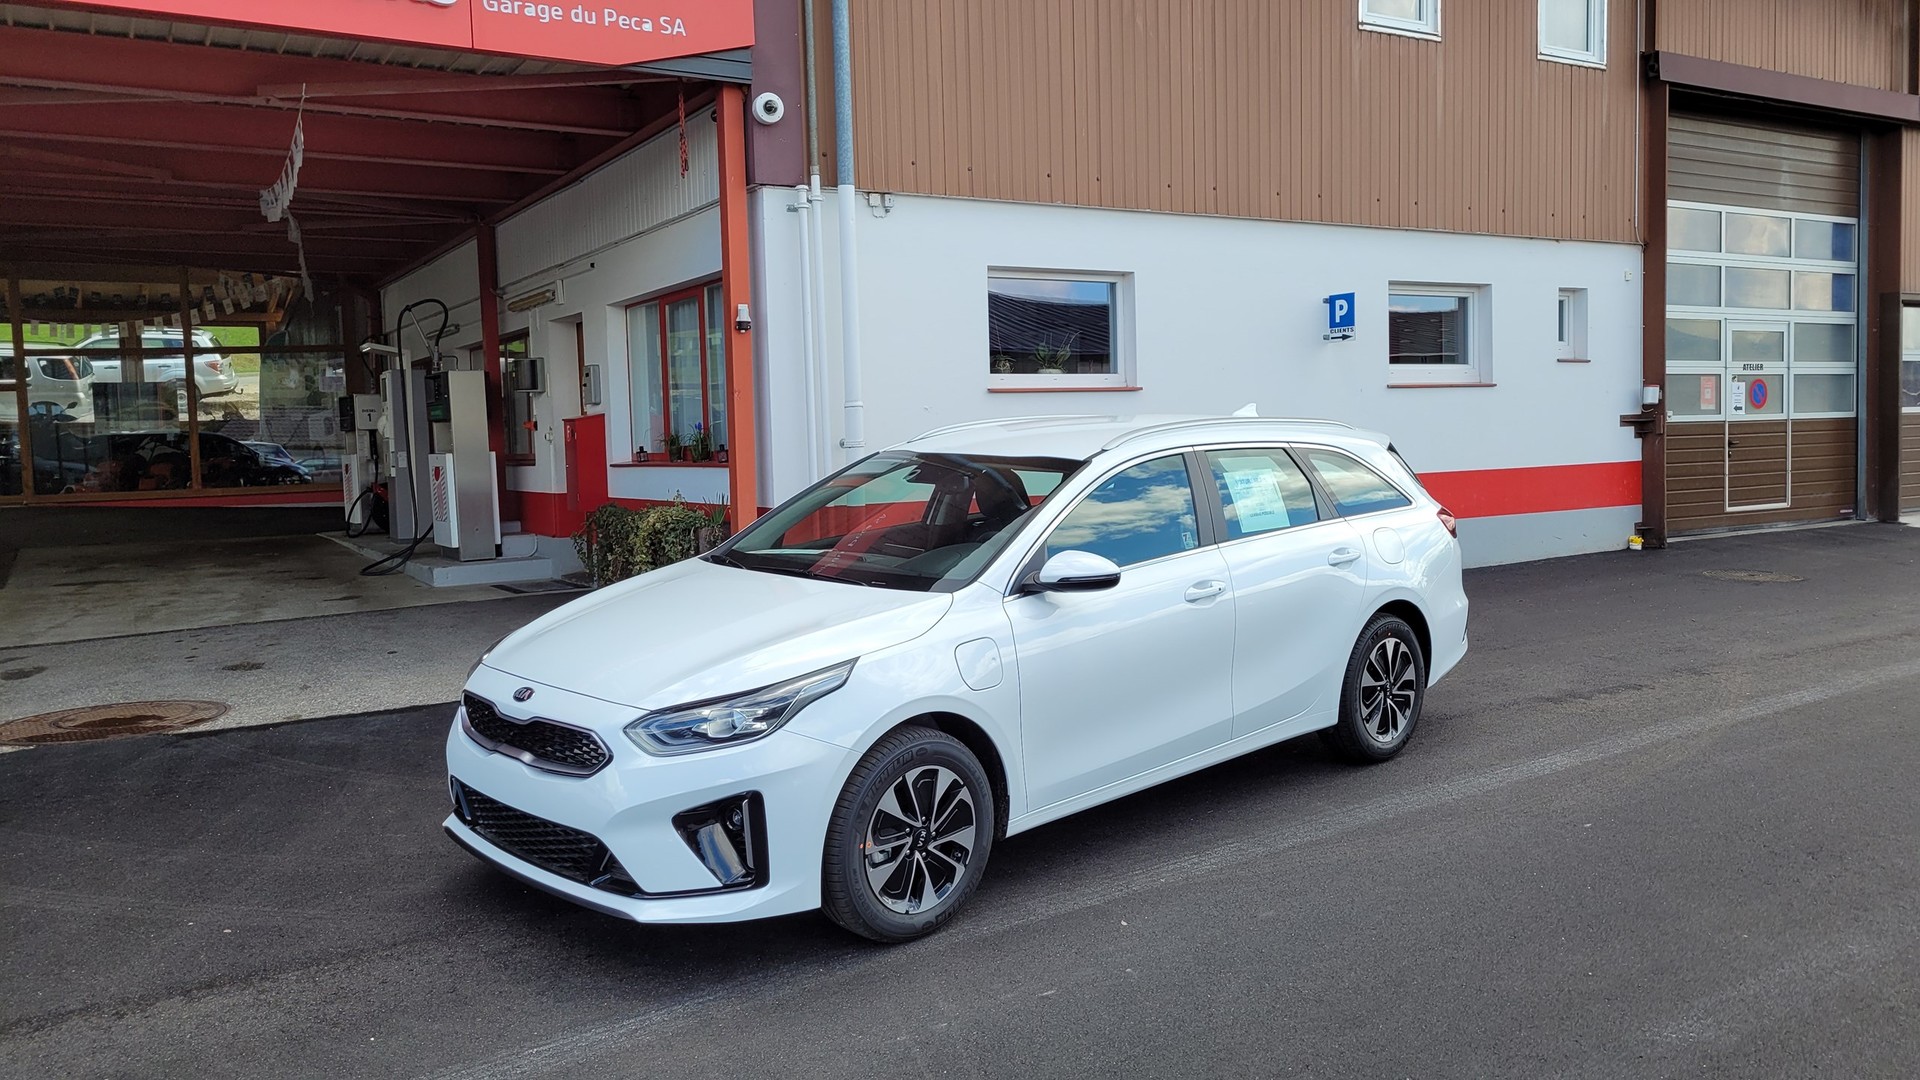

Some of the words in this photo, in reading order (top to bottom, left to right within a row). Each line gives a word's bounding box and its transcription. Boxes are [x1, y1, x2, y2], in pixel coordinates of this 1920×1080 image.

[483, 0, 563, 23] Garage
[571, 5, 596, 25] du
[605, 9, 653, 32] Peca
[660, 17, 687, 37] SA
[1335, 299, 1348, 323] P
[1743, 363, 1764, 371] ATELIER
[513, 687, 531, 700] KIA
[864, 752, 914, 806] MICHELIN
[917, 831, 927, 847] KIA
